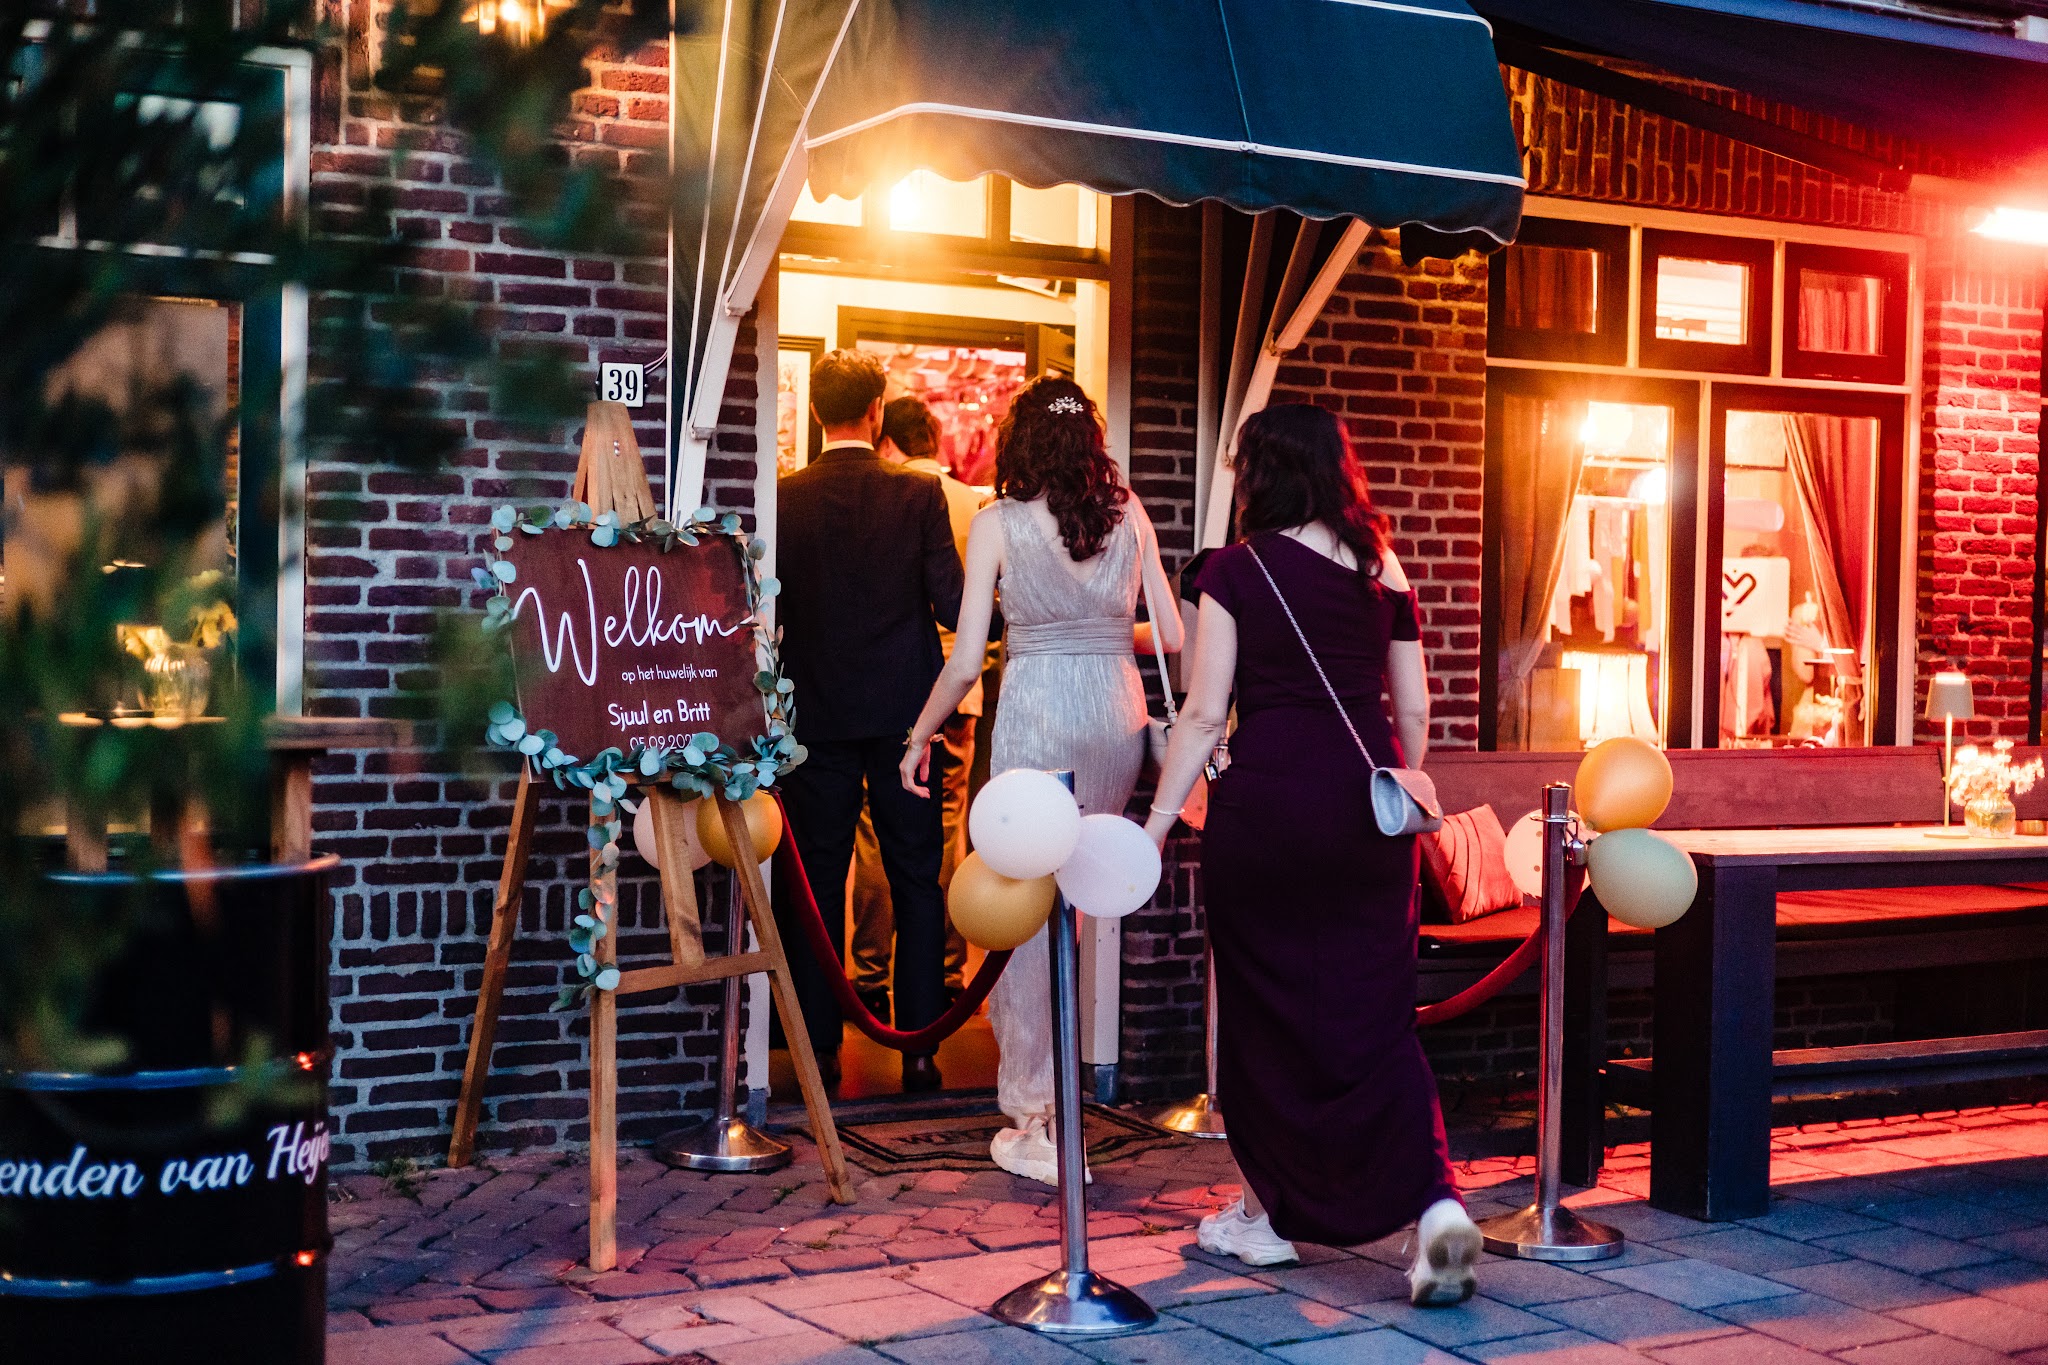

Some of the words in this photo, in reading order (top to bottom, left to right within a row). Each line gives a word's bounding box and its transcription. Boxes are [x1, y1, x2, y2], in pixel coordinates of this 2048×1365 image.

[608, 369, 638, 401] 39
[511, 558, 755, 687] Welkom
[621, 671, 636, 685] op
[636, 664, 655, 680] het
[655, 663, 697, 683] huwelijk
[698, 668, 718, 679] van
[608, 699, 649, 732] Sjuul
[653, 708, 673, 724] en
[677, 699, 711, 722] Britt
[159, 1152, 253, 1195] van
